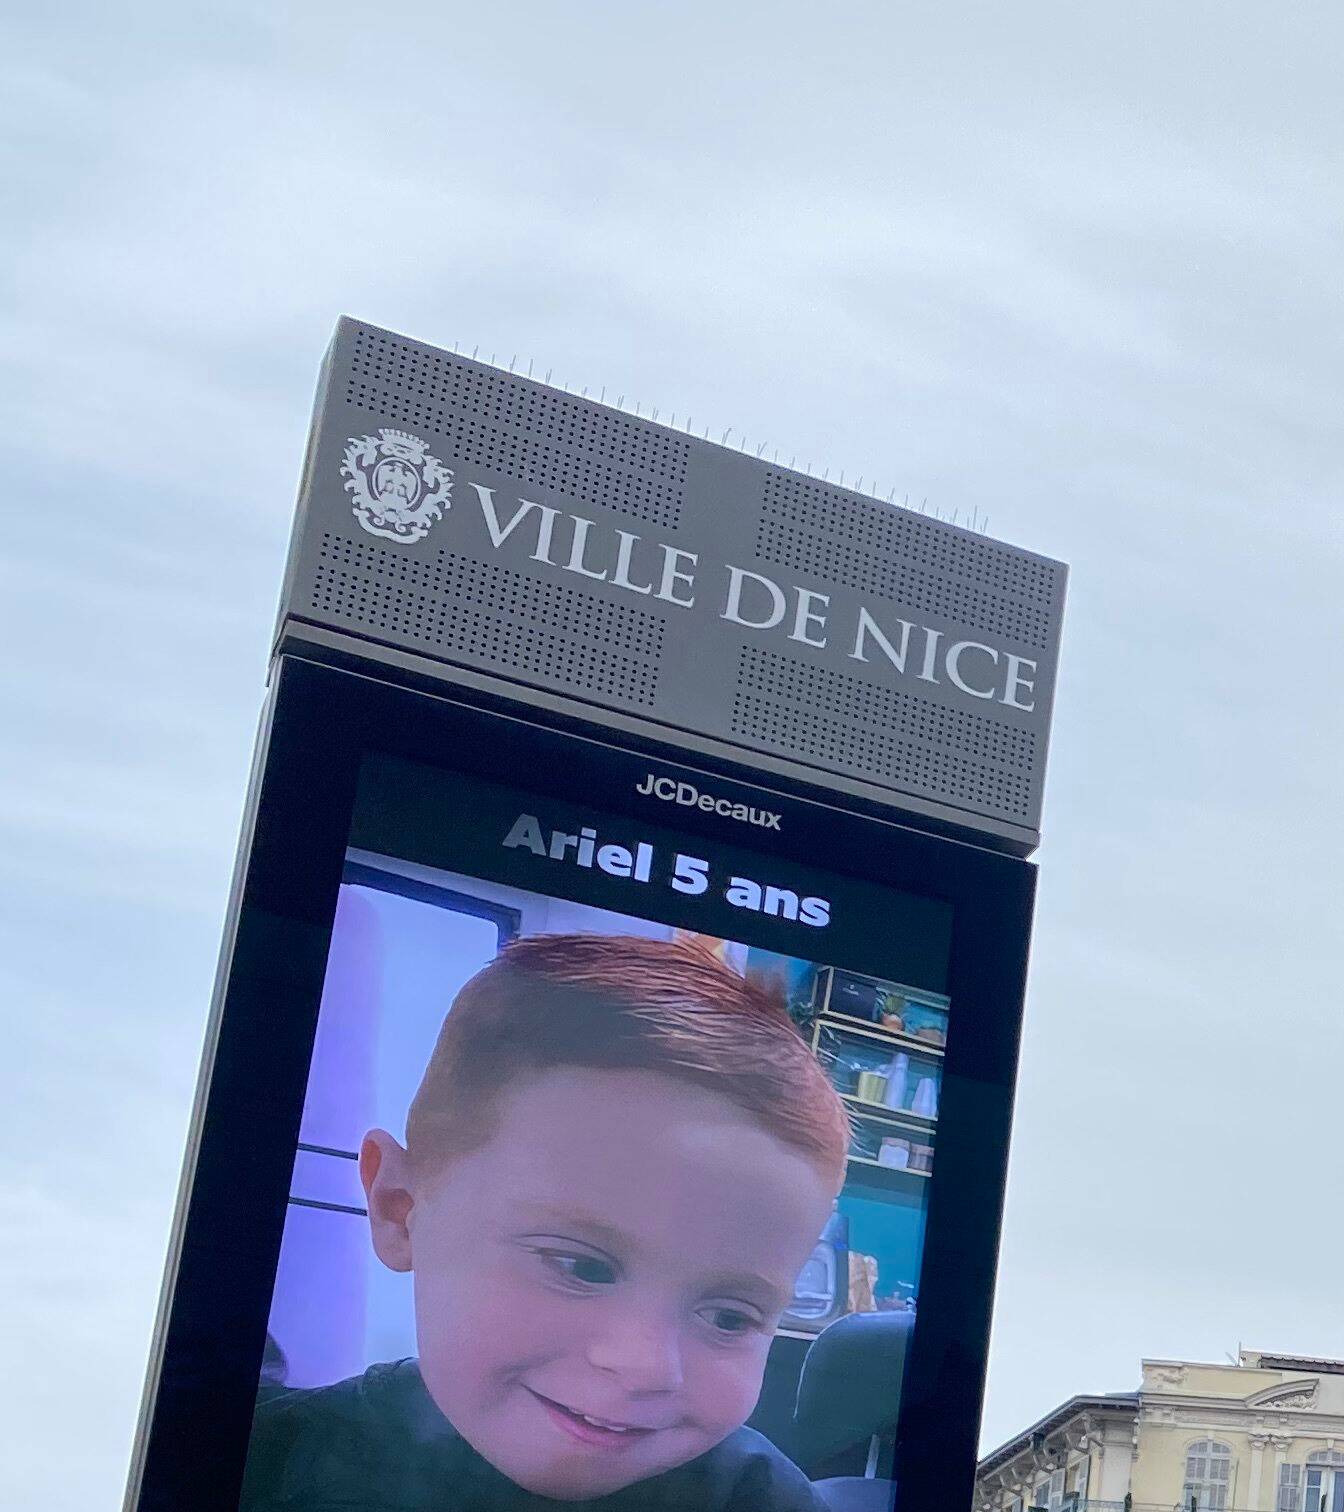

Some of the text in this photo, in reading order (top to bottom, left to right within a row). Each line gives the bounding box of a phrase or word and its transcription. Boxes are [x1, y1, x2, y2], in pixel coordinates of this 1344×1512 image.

[469, 482, 1038, 714] VILLE DE NICE
[636, 773, 783, 832] JCDecaux
[502, 812, 832, 928] Ariel 5 ans
